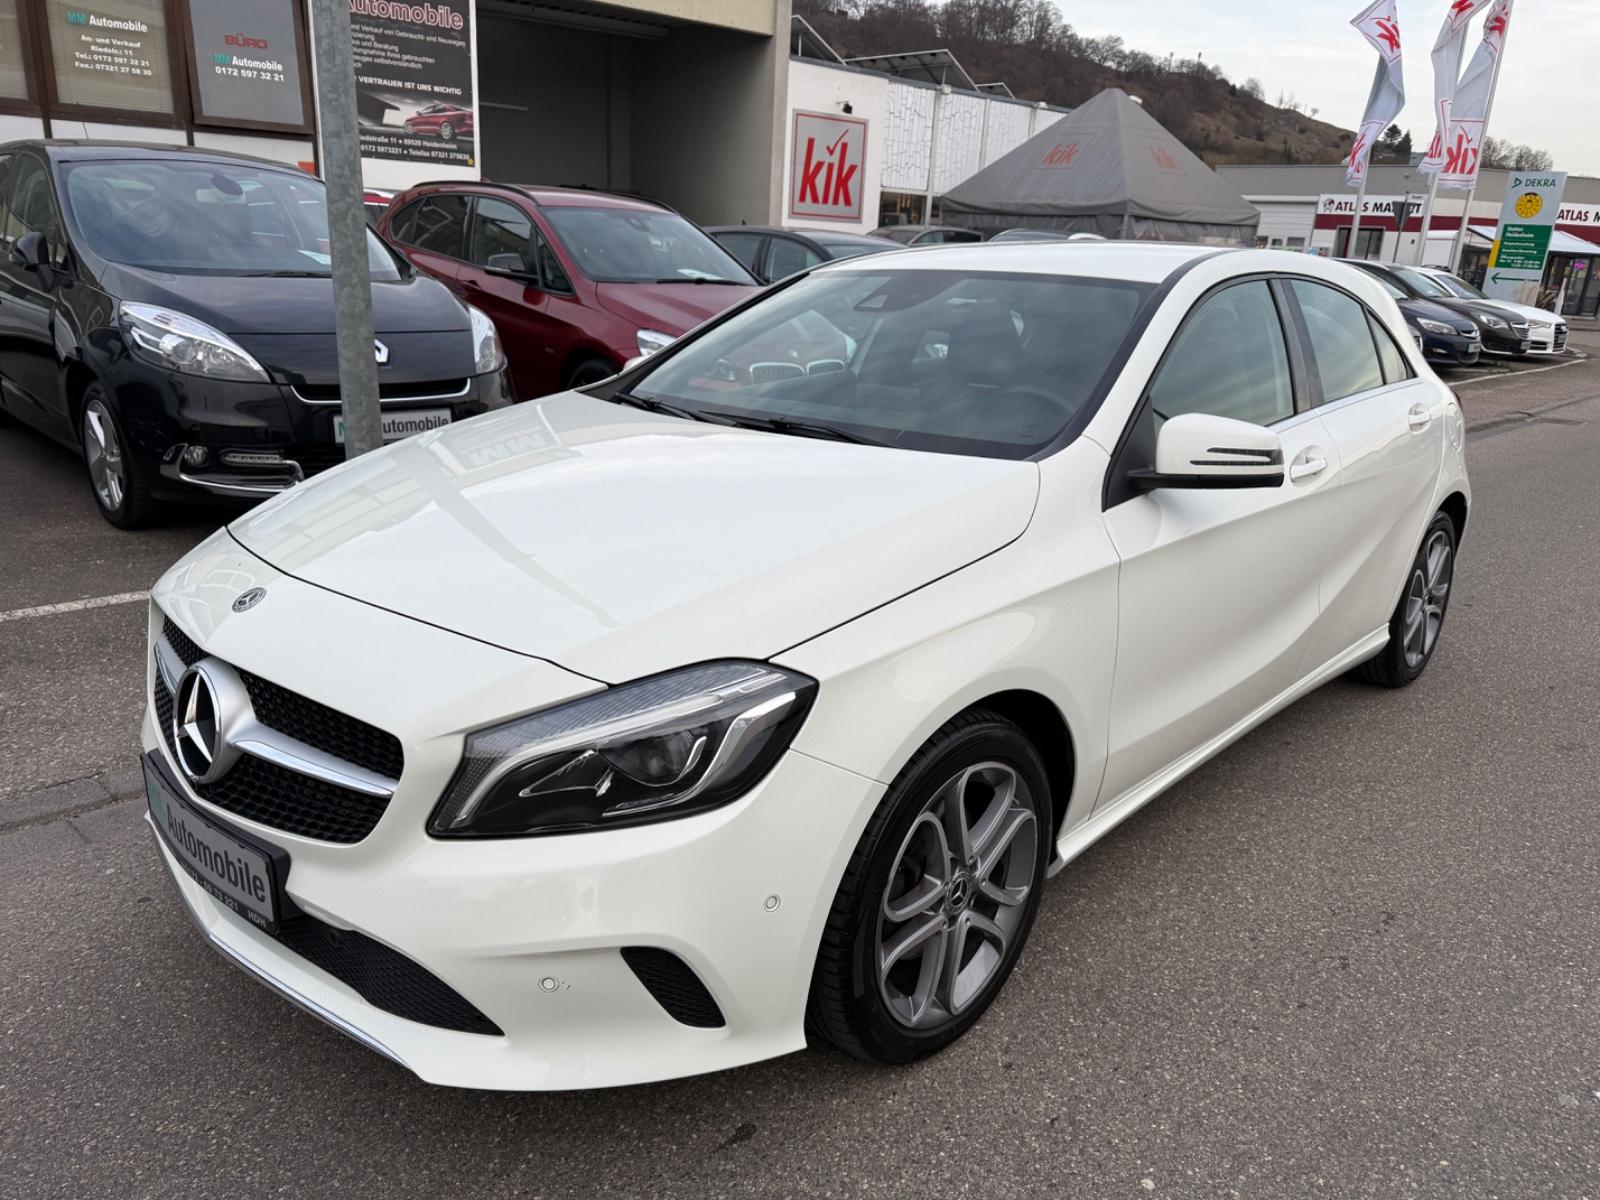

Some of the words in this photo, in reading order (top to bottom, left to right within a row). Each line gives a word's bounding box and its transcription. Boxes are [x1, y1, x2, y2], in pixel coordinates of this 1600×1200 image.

[89, 14, 148, 33] Automobile
[95, 37, 110, 45] und
[111, 38, 141, 48] Verkauf
[224, 32, 268, 50] BÜRO
[93, 54, 112, 63] 0172
[232, 56, 283, 72] Automobile
[95, 63, 119, 73] 07321
[215, 65, 239, 77] 0172
[240, 69, 258, 79] 597
[260, 72, 271, 81] 32
[273, 73, 284, 82] 21
[359, 75, 403, 89] VERTRAUEN
[404, 81, 416, 90] IST
[417, 82, 432, 92] UNS
[433, 85, 462, 96] WICHTIG
[360, 144, 376, 152] 0172
[798, 134, 858, 208] kik
[1524, 178, 1557, 188] DEKRA
[1334, 202, 1369, 213] ATLS
[1371, 202, 1422, 214] MAT
[1557, 208, 1590, 222] ATLAS
[166, 803, 266, 903] Automobile
